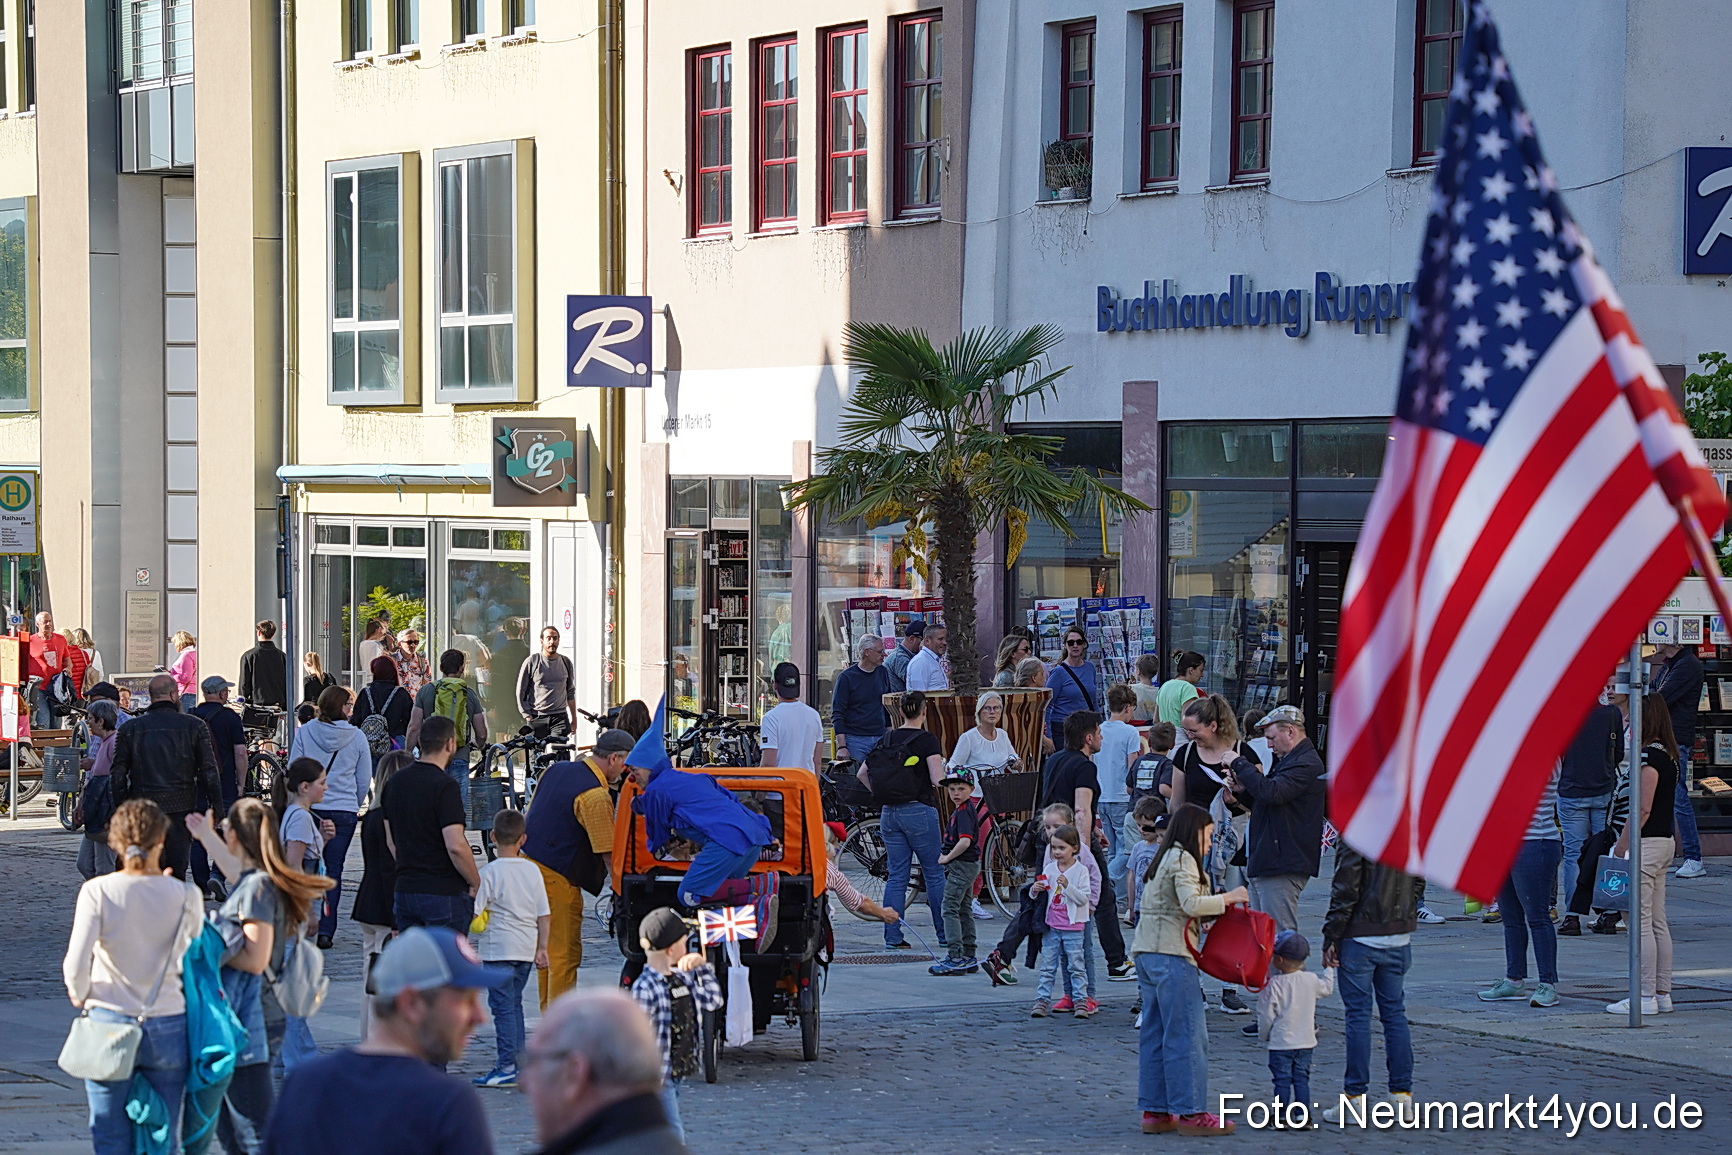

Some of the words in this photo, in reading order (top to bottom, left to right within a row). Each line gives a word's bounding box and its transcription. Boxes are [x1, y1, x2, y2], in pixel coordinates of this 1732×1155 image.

[1097, 274, 1309, 338] Buchhandlung
[704, 413, 712, 430] 15
[526, 442, 555, 478] G2
[5, 483, 21, 504] H
[1608, 875, 1621, 891] G2
